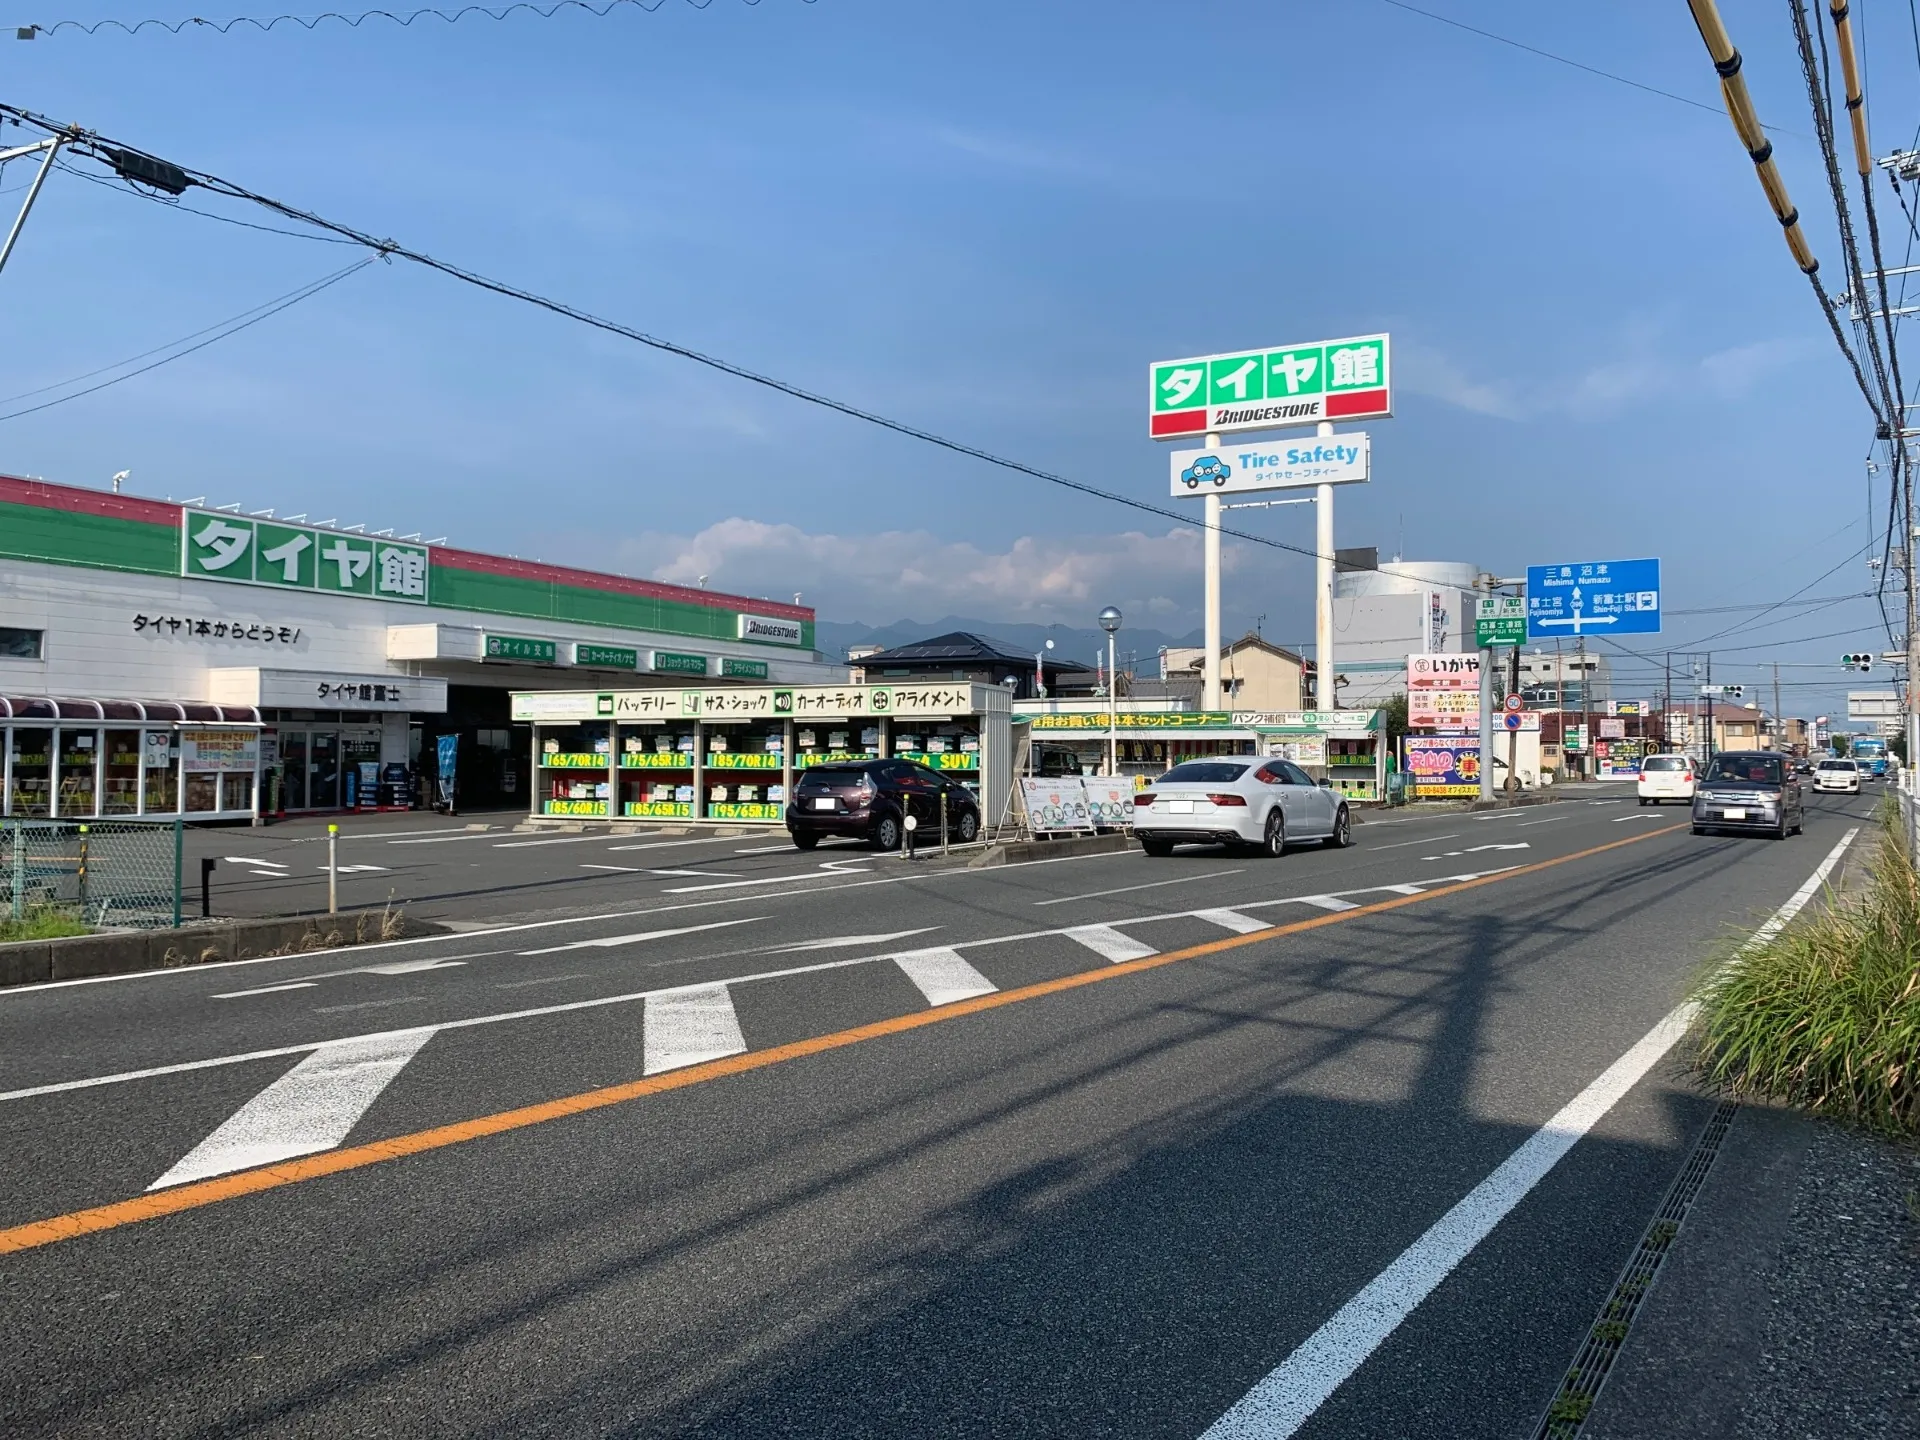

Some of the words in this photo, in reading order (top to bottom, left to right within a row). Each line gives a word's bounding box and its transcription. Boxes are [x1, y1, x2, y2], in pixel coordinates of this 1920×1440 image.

[1160, 345, 1379, 406] タイヤ館
[1214, 402, 1320, 426] BRIDGESTONE
[1238, 452, 1280, 470] Tire
[1286, 445, 1359, 466] Safety
[1256, 468, 1339, 481] タイヤセーフティー
[191, 519, 426, 597] タイヤ館
[1546, 566, 1572, 578] 三島
[1581, 564, 1608, 576] 沼津
[1543, 578, 1575, 587] Mishima
[1579, 577, 1611, 585] Numazu
[1483, 600, 1494, 608] E1
[1506, 598, 1521, 607] E1A
[1530, 596, 1563, 608] 富士宮
[1592, 592, 1636, 605] 新富士駅
[1529, 608, 1564, 617] Fujinomiya
[1593, 605, 1623, 614] Shin-Fuji
[132, 614, 302, 645] タイヤ1本からどうぞ!
[748, 620, 799, 640] BRIDGESTONE
[1480, 620, 1523, 630] 西富士道路
[503, 641, 553, 657] オイル交換
[1432, 658, 1480, 673] いがや
[317, 683, 401, 702] タイヤ館富士
[896, 690, 966, 708] アライメント
[617, 697, 677, 712] バッテリー
[704, 696, 767, 710] サス・ショック
[797, 692, 863, 709] カーオーディオ
[1508, 698, 1519, 707] 50
[548, 754, 605, 767] 165/70R14
[626, 754, 686, 767] 175/65R15
[712, 754, 776, 768] 185/70R14
[940, 754, 970, 769] SUV
[1409, 751, 1453, 771] 安心の
[1462, 759, 1476, 773] 車
[549, 802, 606, 815] 185/60R15
[630, 803, 690, 817] 185/65R15
[714, 804, 778, 819] 195/65R15
